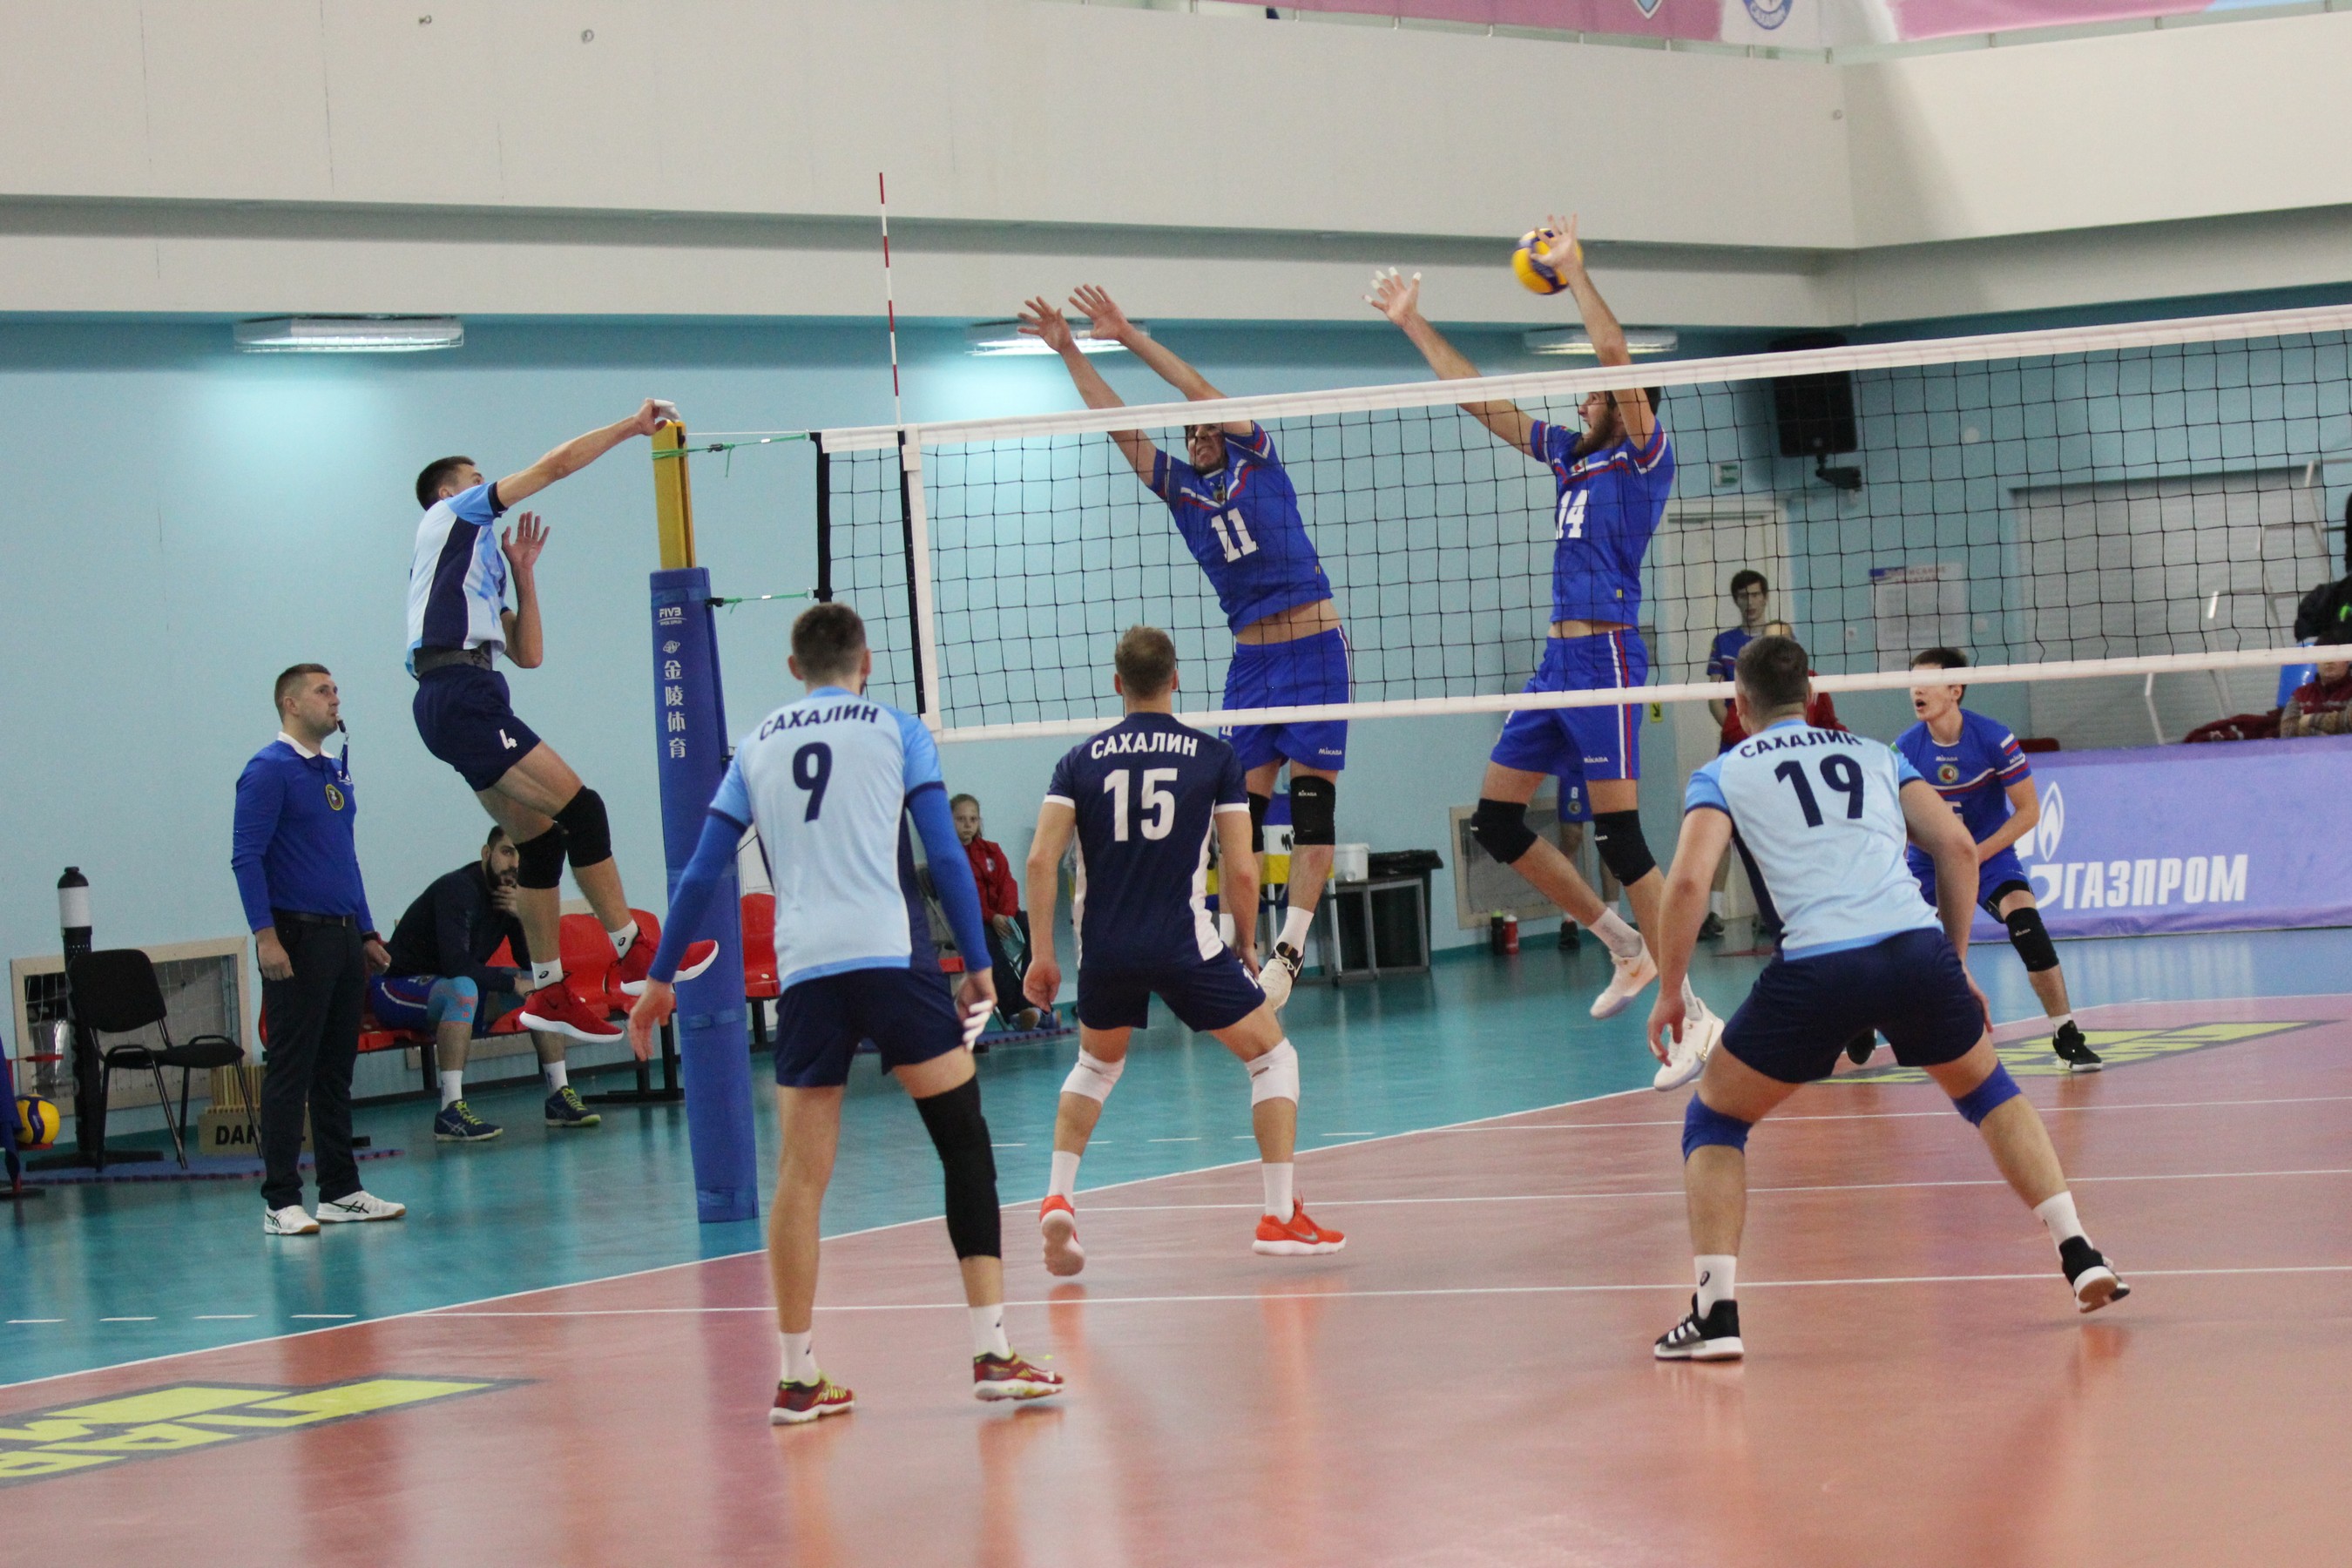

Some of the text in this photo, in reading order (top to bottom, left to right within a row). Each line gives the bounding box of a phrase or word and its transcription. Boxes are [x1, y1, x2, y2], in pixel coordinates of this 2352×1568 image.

[1211, 508, 1258, 563] 11
[1556, 490, 1589, 539] 14
[664, 659, 686, 759] 金陵体育
[760, 704, 879, 740] САХАЛИН
[499, 728, 517, 749] 4
[1091, 732, 1199, 760] САХАЛИН
[1739, 728, 1862, 759] САХАЛИН
[793, 741, 833, 823] 9
[1104, 767, 1179, 841] 15
[1774, 754, 1864, 828] 19
[2063, 854, 2248, 910] ГАЗПРОМ
[215, 1125, 261, 1146] DAN
